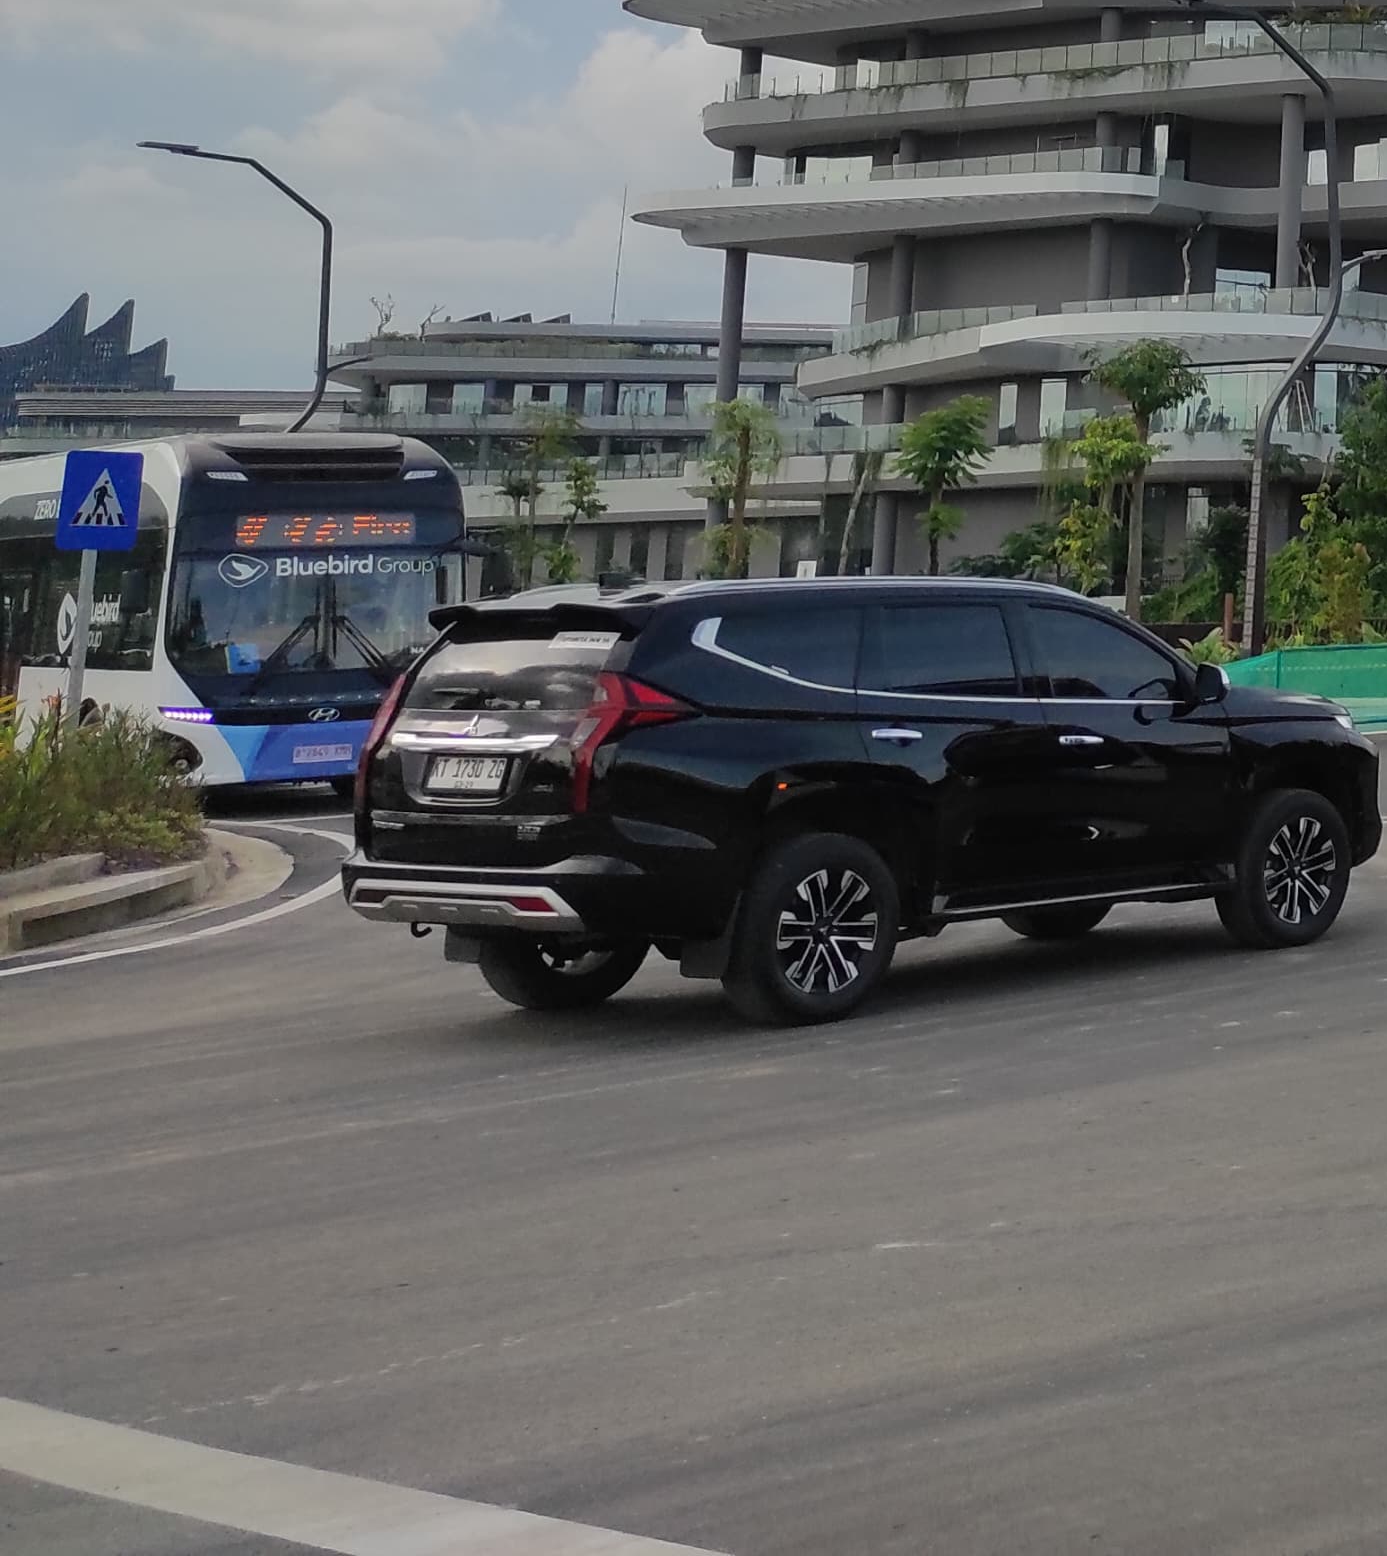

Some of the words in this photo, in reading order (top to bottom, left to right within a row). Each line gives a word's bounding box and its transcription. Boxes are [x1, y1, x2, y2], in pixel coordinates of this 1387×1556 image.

[276, 554, 374, 577] Bluebird
[377, 557, 434, 576] Group
[91, 594, 121, 622] uebird
[432, 759, 450, 778] KT
[452, 759, 485, 778] 1730
